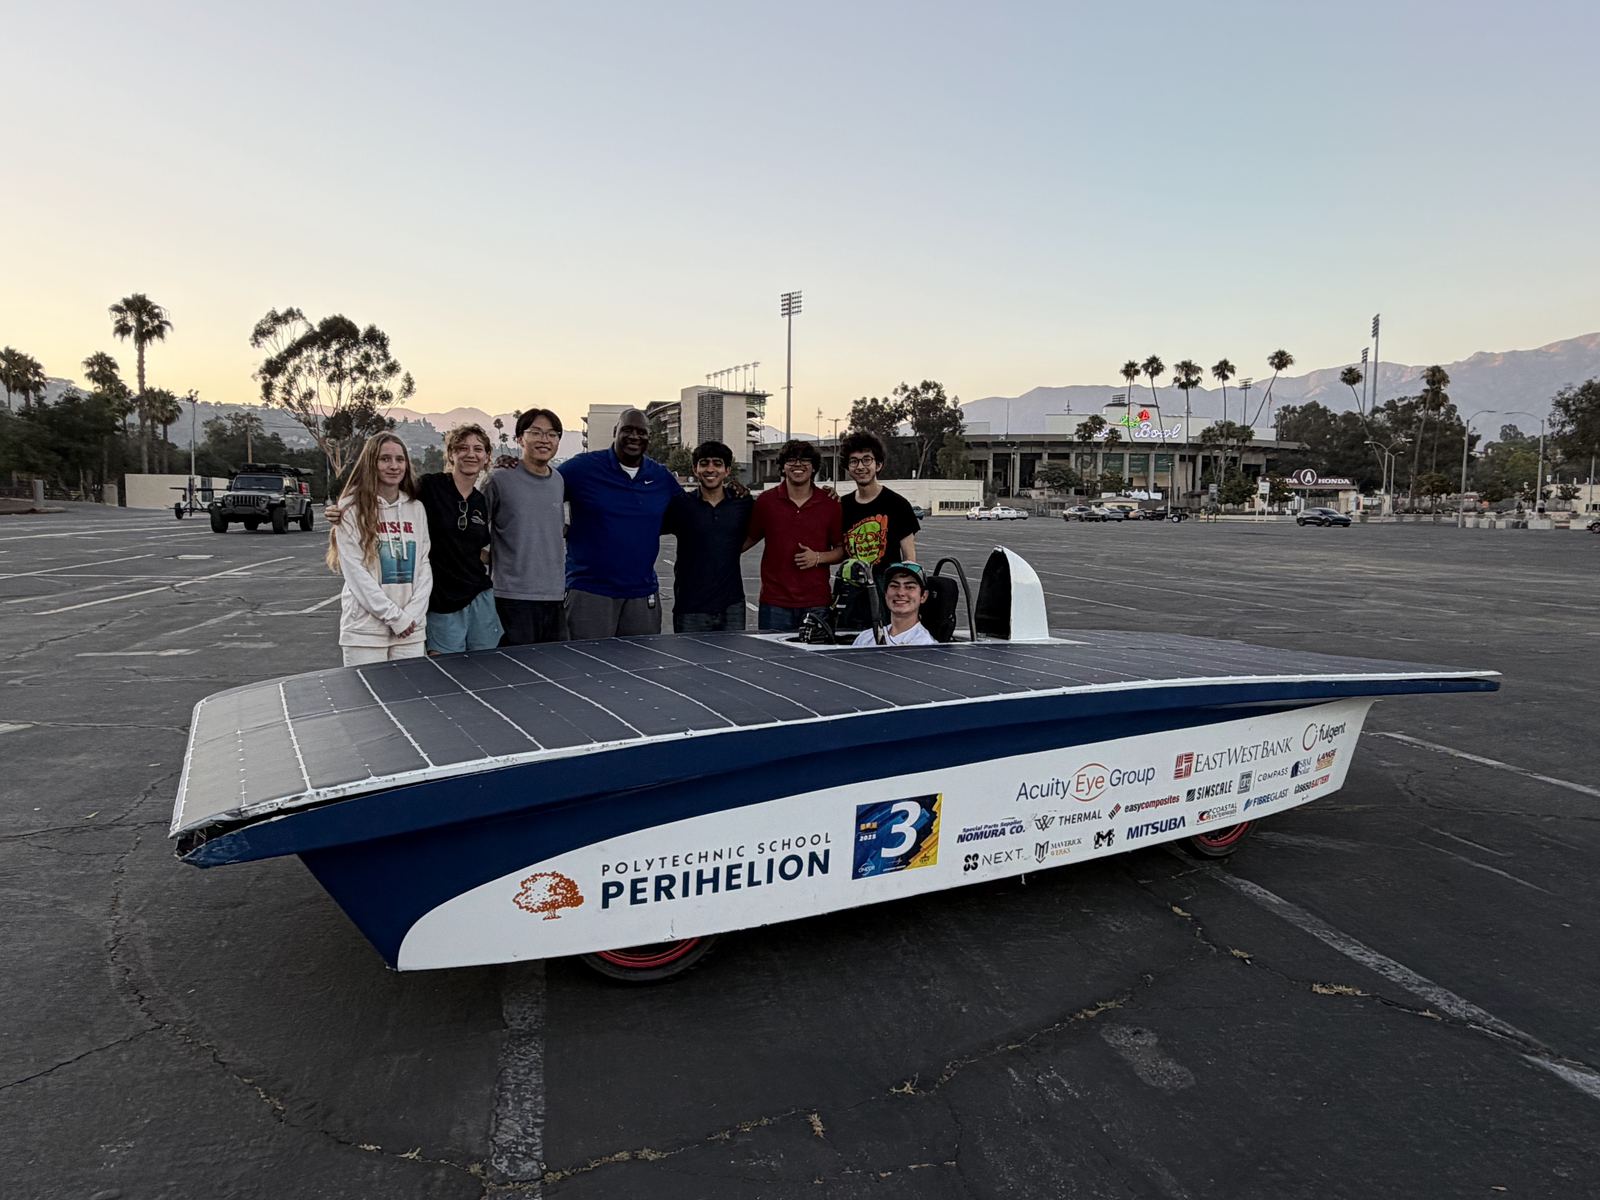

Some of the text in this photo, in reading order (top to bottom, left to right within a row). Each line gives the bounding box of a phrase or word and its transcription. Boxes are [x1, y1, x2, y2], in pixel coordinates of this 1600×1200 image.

[1135, 422, 1181, 438] Bowl
[1318, 721, 1346, 743] fulgent
[1257, 767, 1289, 782] COMPASS
[1016, 767, 1155, 801] Acuity Eye Group
[1196, 780, 1233, 800] SIMSCALE
[1124, 795, 1180, 813] easycomposites
[1252, 788, 1289, 807] FIBREGLAST
[1212, 802, 1238, 814] COASTAL
[1059, 809, 1103, 826] THERMAL
[881, 801, 921, 858] 3
[957, 825, 1026, 843] NOMURA CO.
[1126, 815, 1186, 840] MITSUBA
[1051, 838, 1082, 849] MAVERICK
[601, 832, 832, 876] POLYTECHNIC SCHOOL
[982, 848, 1023, 866] NEXT
[601, 848, 831, 909] PERIHELION
